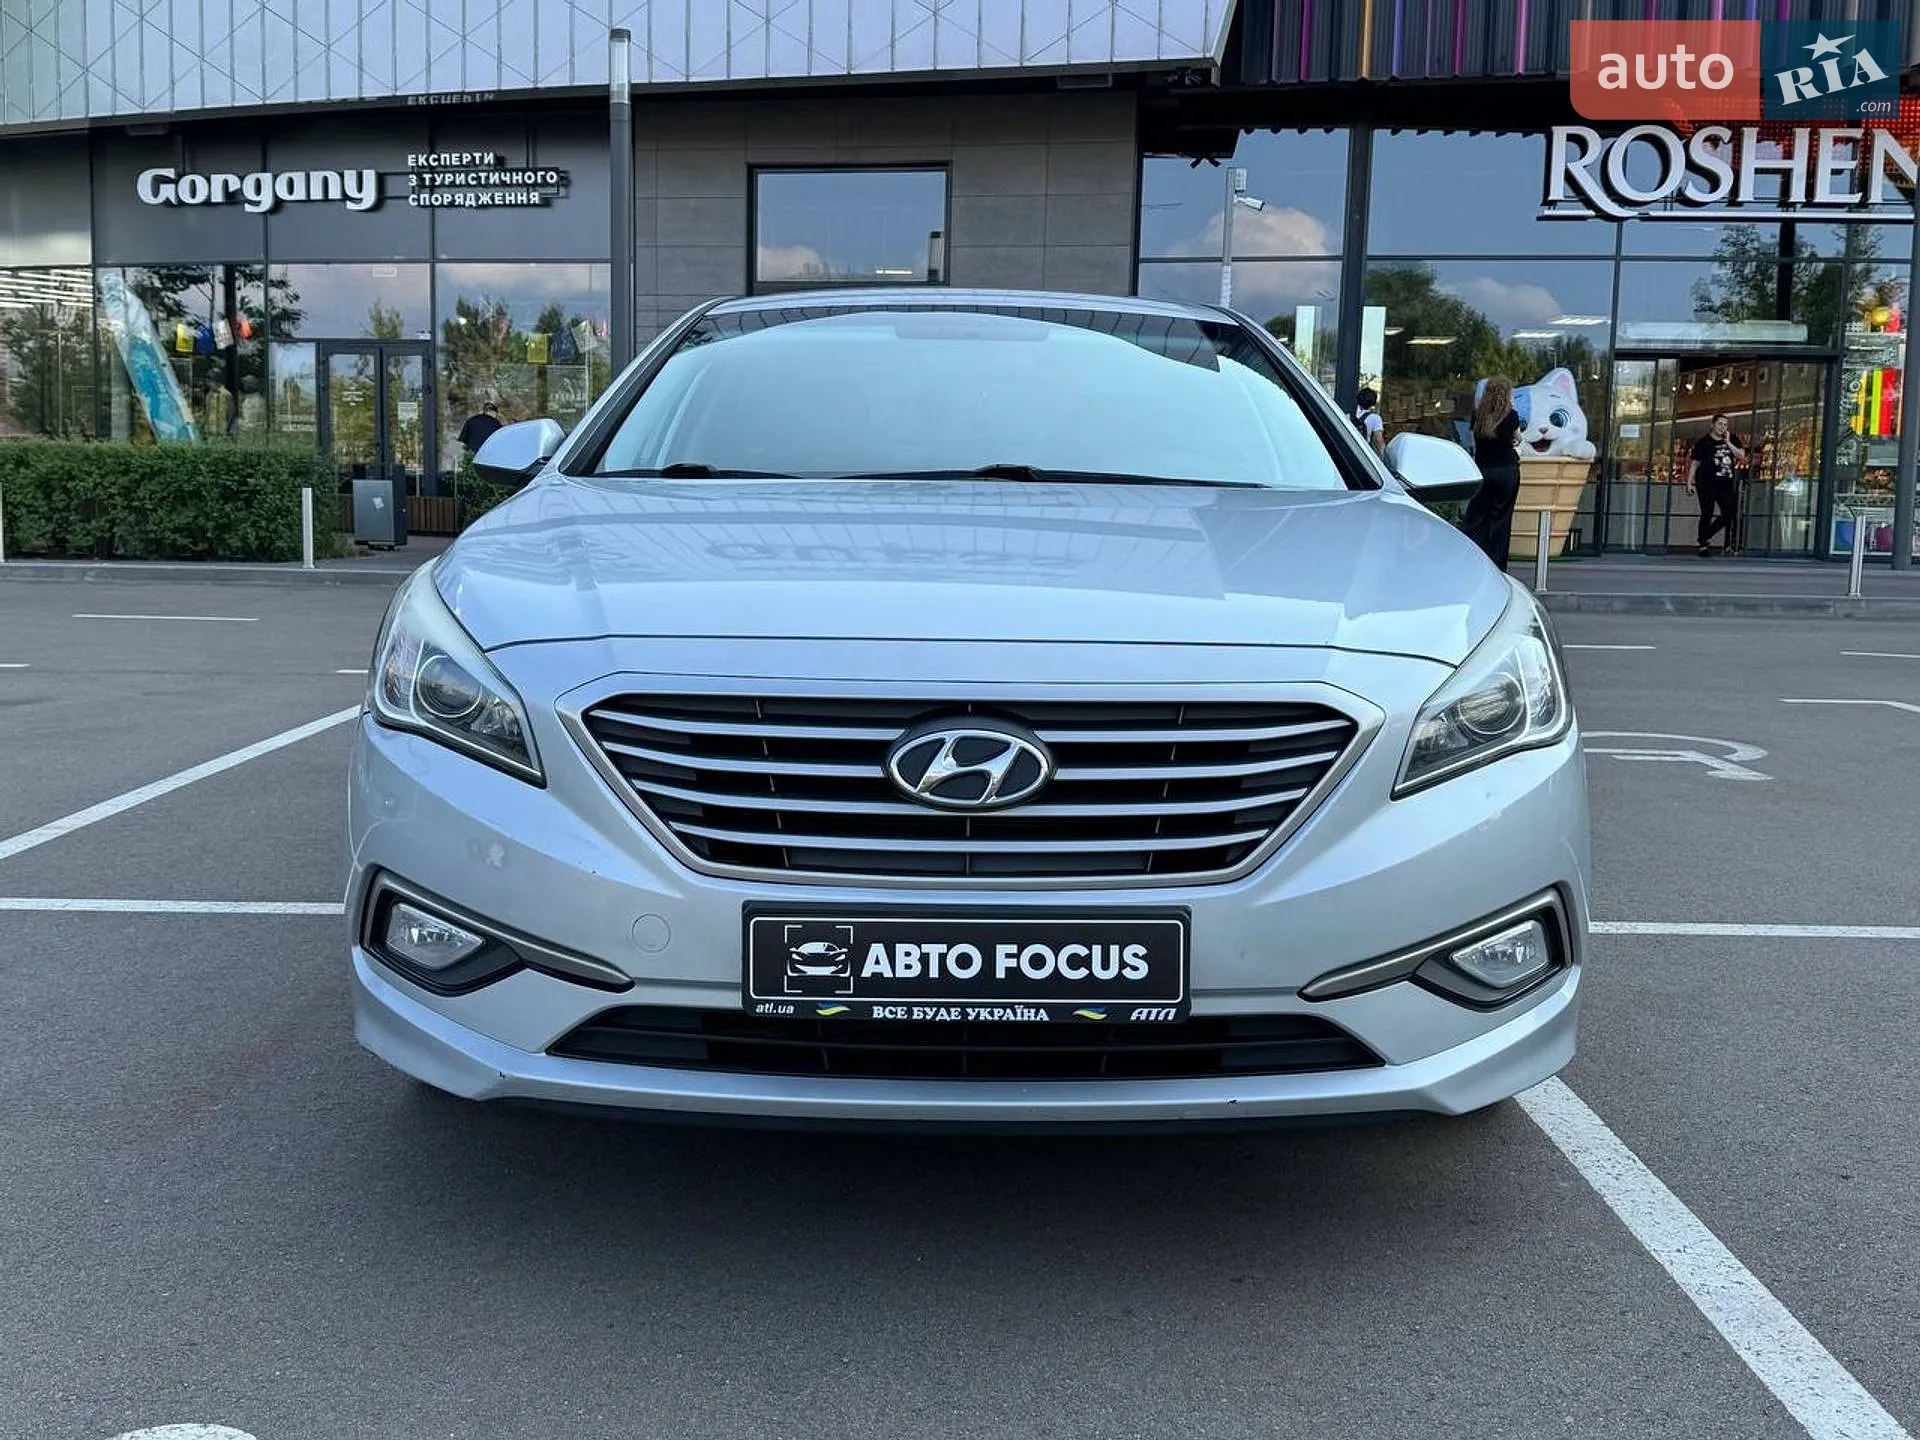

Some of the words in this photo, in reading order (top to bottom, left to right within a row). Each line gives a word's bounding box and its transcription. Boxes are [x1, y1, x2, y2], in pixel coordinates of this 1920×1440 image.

[407, 151, 495, 167] ЕКСПЕРТИ
[407, 174, 418, 186] З
[422, 170, 558, 186] ТУРИСТИЧНОГО
[136, 167, 377, 213] Gorgany
[407, 191, 540, 207] СПОРЯДЖЕННЯ
[860, 942, 983, 980] АВТО
[995, 943, 1150, 981] FOCUS
[871, 1005, 908, 1020] ВСЕ
[911, 1006, 962, 1021] БУДЕ
[965, 1004, 1050, 1022] УКРАЇНА
